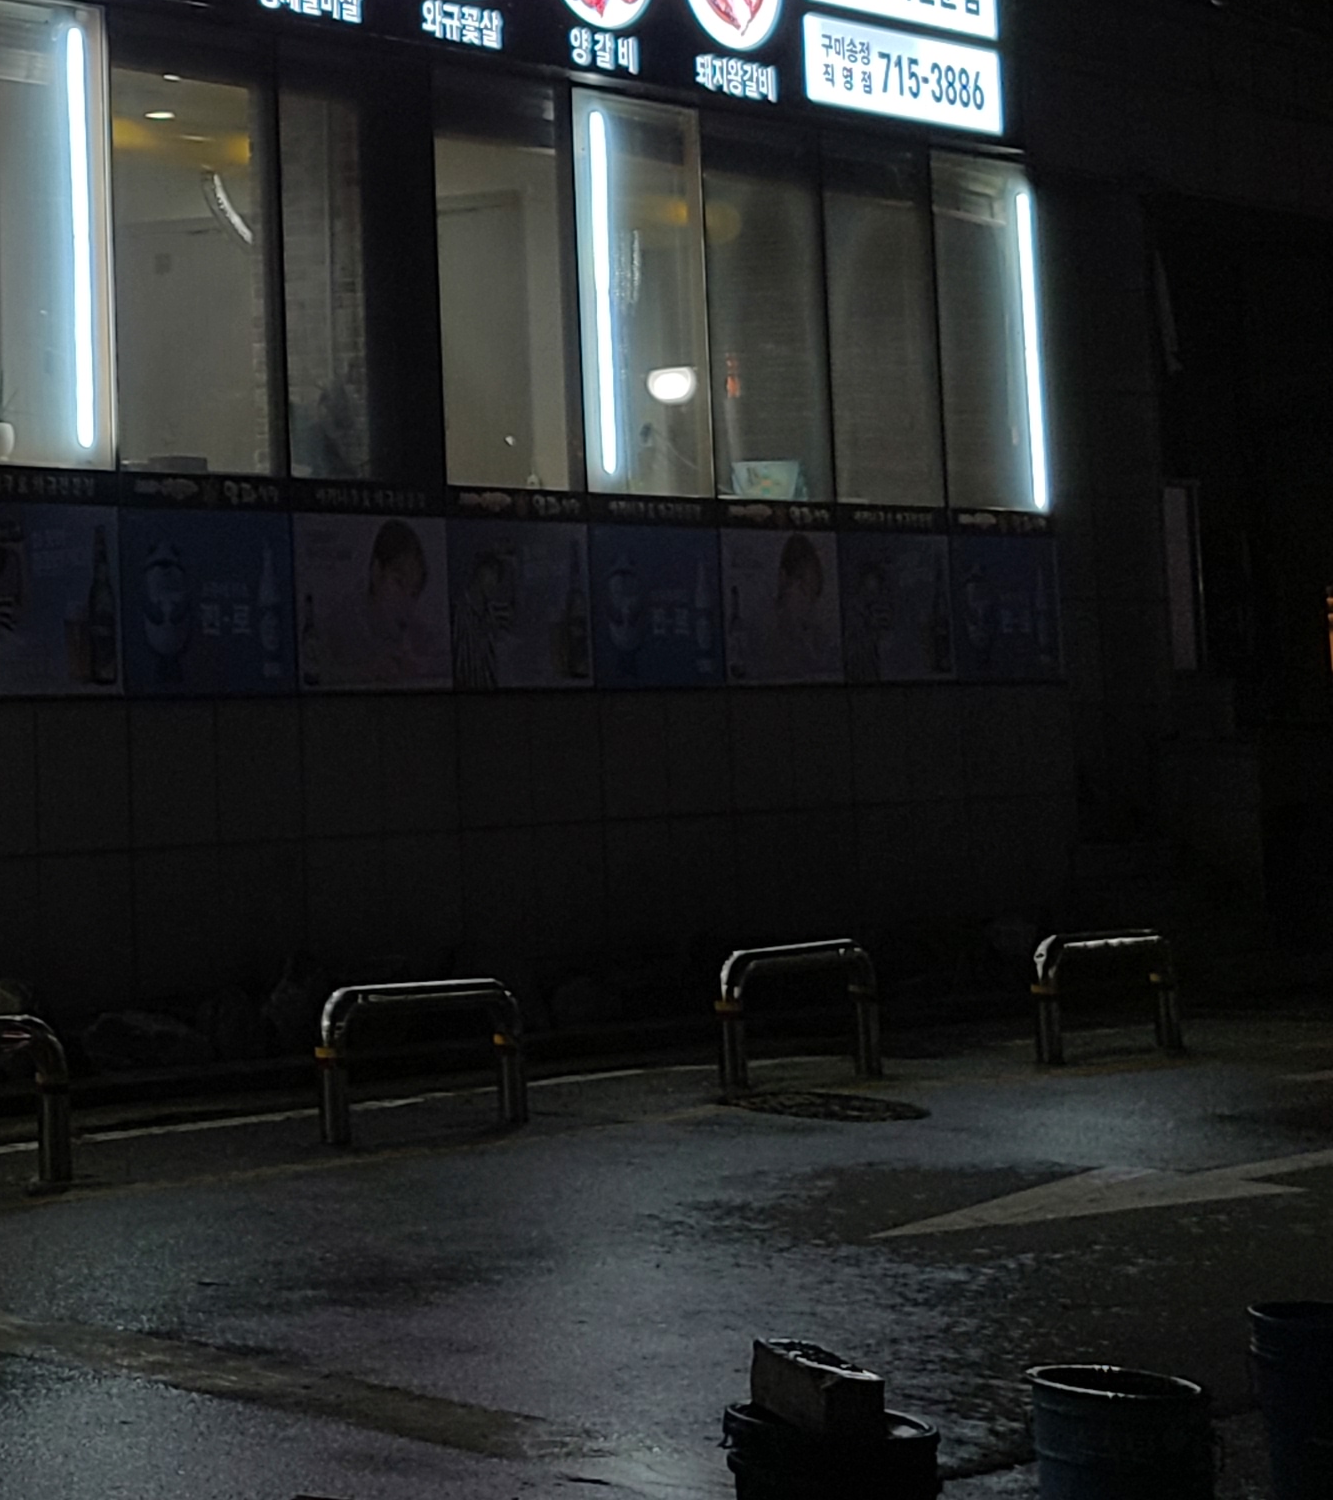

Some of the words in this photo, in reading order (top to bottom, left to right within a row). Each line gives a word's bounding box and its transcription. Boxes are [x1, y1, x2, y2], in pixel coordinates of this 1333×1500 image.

[421, 0, 502, 50] 와규꽃살
[821, 34, 871, 66] 구미송정
[695, 54, 778, 103] 돼지왕갈비
[878, 51, 985, 111] 715-3886
